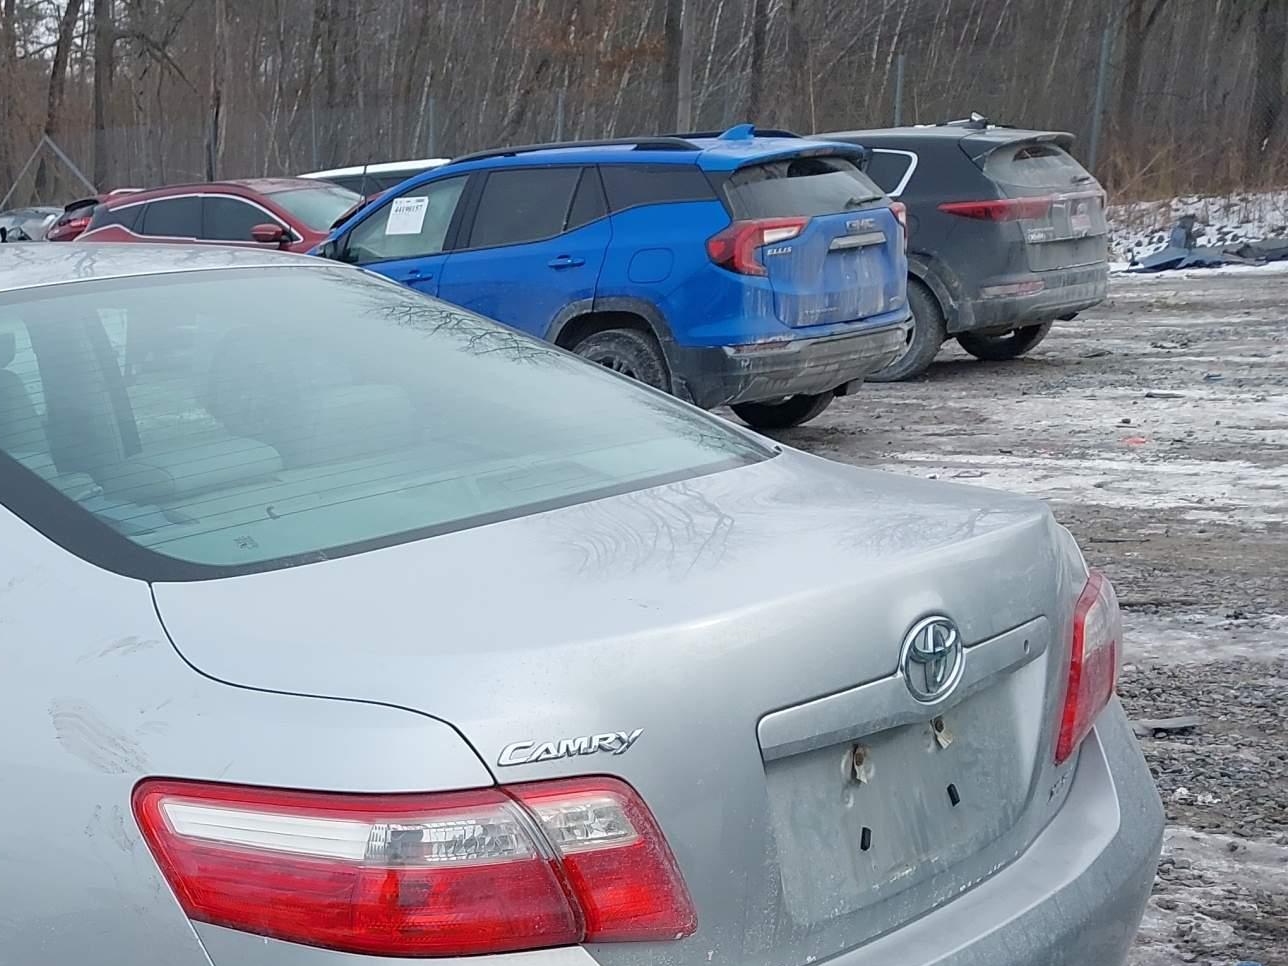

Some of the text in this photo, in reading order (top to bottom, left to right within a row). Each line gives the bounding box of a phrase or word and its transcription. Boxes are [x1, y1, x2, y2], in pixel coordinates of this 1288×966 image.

[846, 218, 875, 231] GMC
[767, 246, 793, 256] ELLIS
[497, 727, 644, 767] CAMRY
